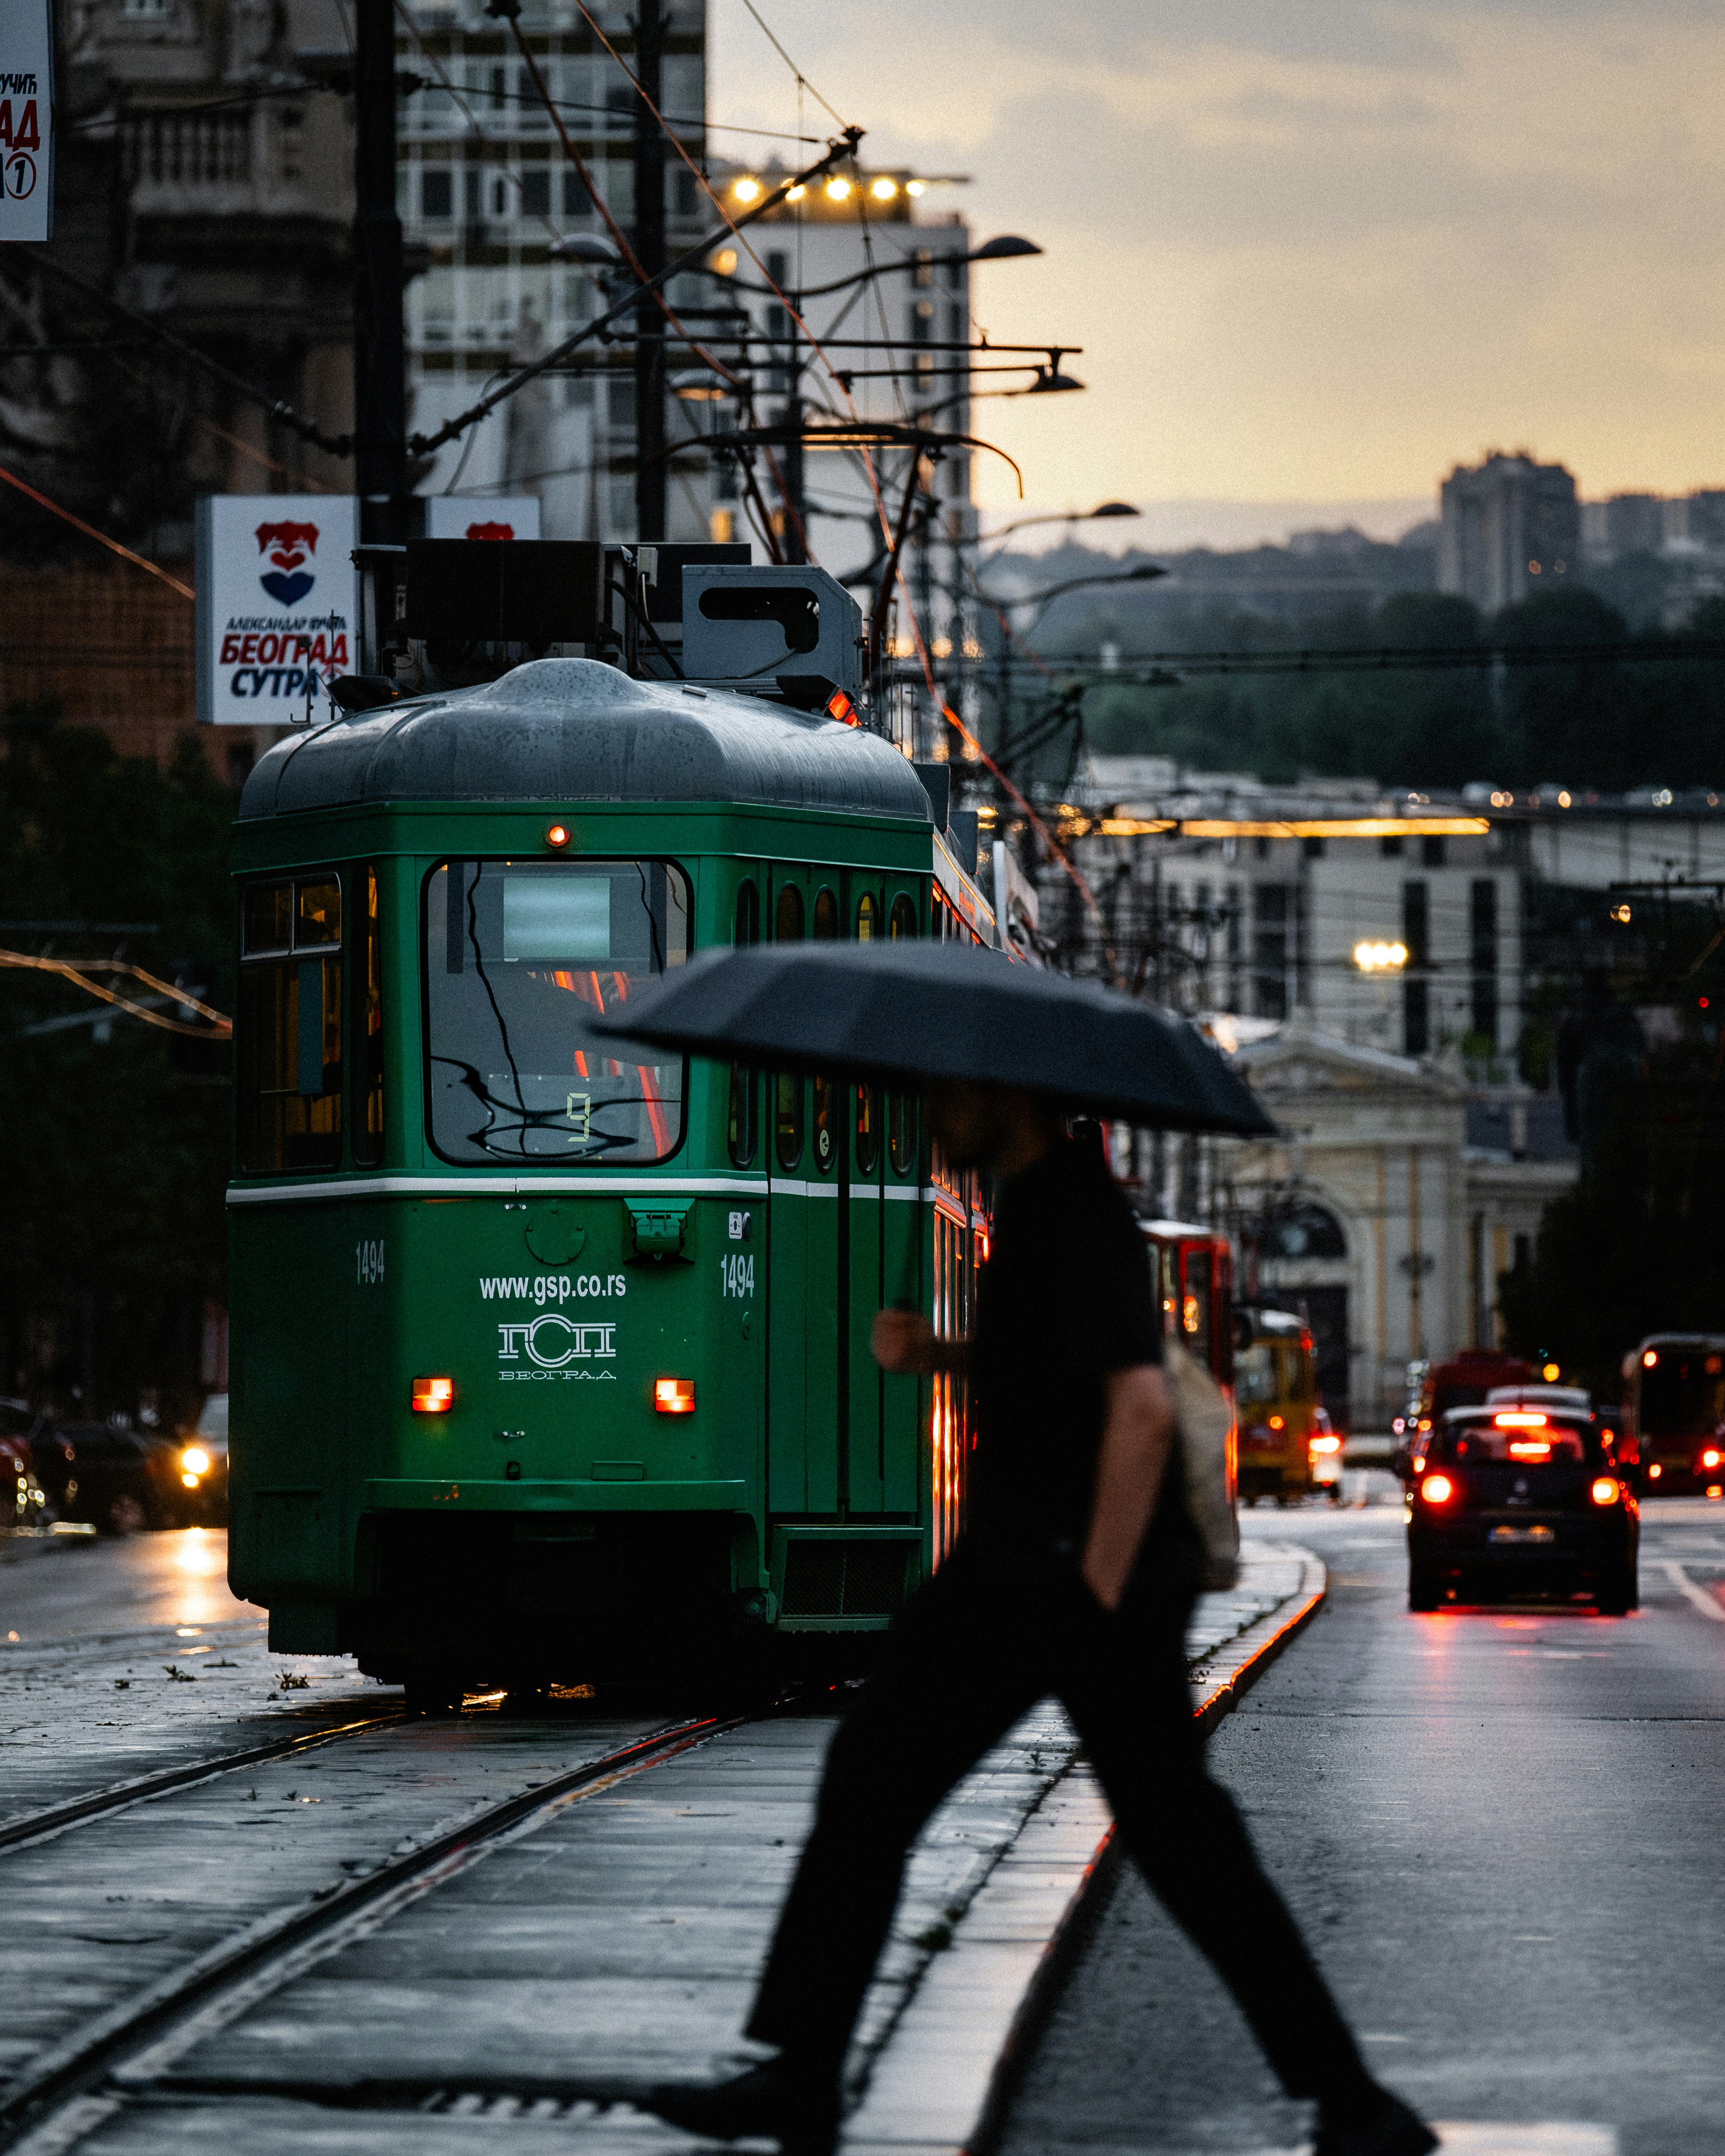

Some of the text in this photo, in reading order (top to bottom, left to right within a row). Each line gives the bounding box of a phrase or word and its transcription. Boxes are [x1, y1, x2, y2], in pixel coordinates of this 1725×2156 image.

[0, 73, 37, 94] УЧИЋ
[15, 160, 26, 193] 1
[231, 668, 319, 697] СУТРА
[566, 1093, 591, 1142] 9
[356, 1240, 384, 1285] 1494
[721, 1254, 754, 1298] 1494
[479, 1274, 626, 1306] www.gsp.co.rs
[498, 1314, 616, 1368] ГСП
[498, 1370, 617, 1380] БЕОГРАД
